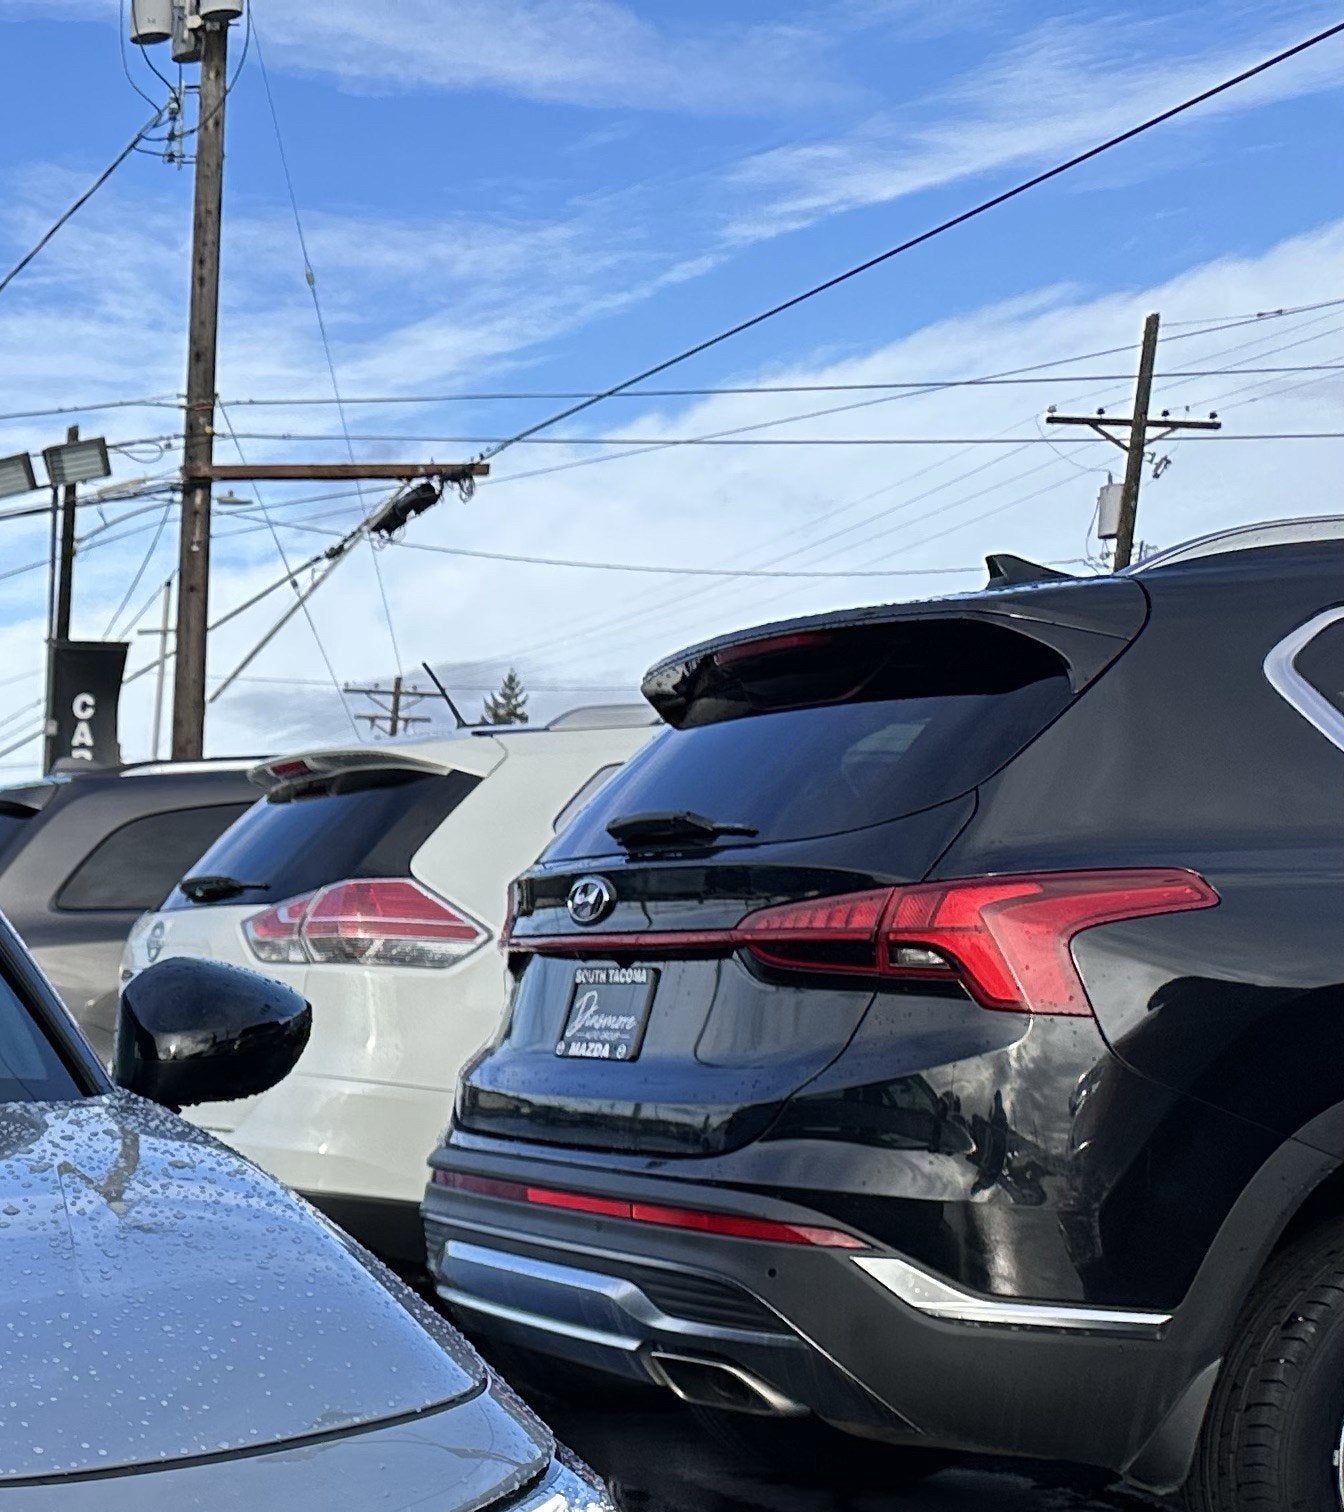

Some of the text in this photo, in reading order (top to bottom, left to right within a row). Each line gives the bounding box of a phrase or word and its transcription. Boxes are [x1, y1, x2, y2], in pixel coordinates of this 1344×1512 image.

[575, 968, 647, 983] SOUTH TACOMA
[568, 1041, 610, 1058] MAZDA
